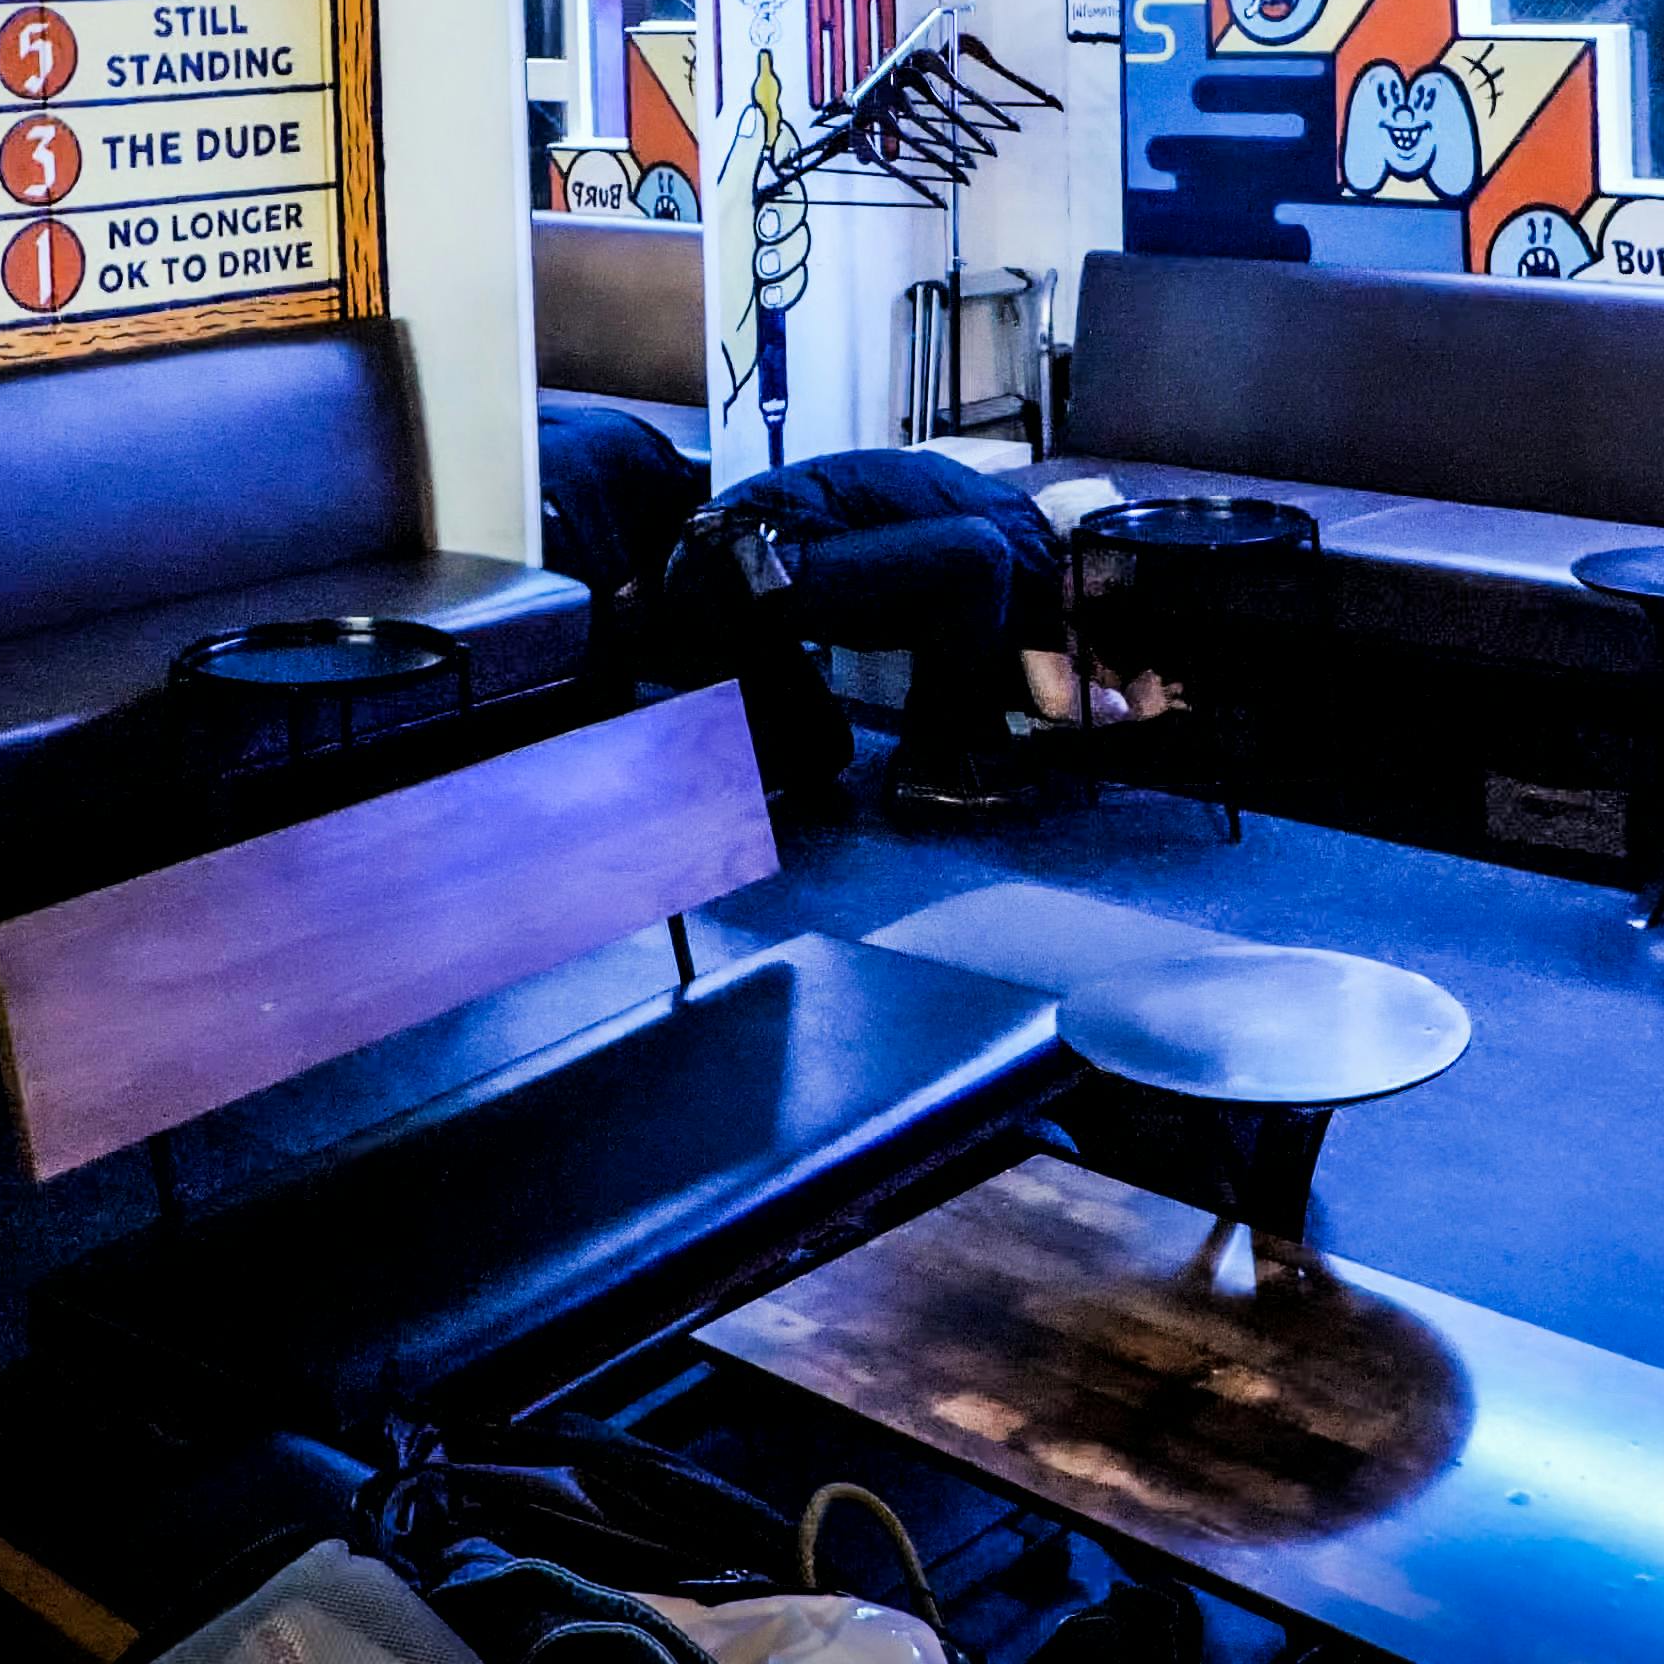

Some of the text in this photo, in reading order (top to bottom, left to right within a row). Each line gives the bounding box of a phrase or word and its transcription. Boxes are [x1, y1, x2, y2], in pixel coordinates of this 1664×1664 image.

[154, 4, 248, 37] STILL
[19, 21, 54, 95] 5
[107, 46, 293, 87] STANDING
[23, 124, 56, 197] 3
[102, 121, 301, 170] THE DUDE
[107, 202, 304, 250] NO LONGER
[35, 227, 53, 305] 1
[98, 241, 314, 293] OK TO DRIVE
